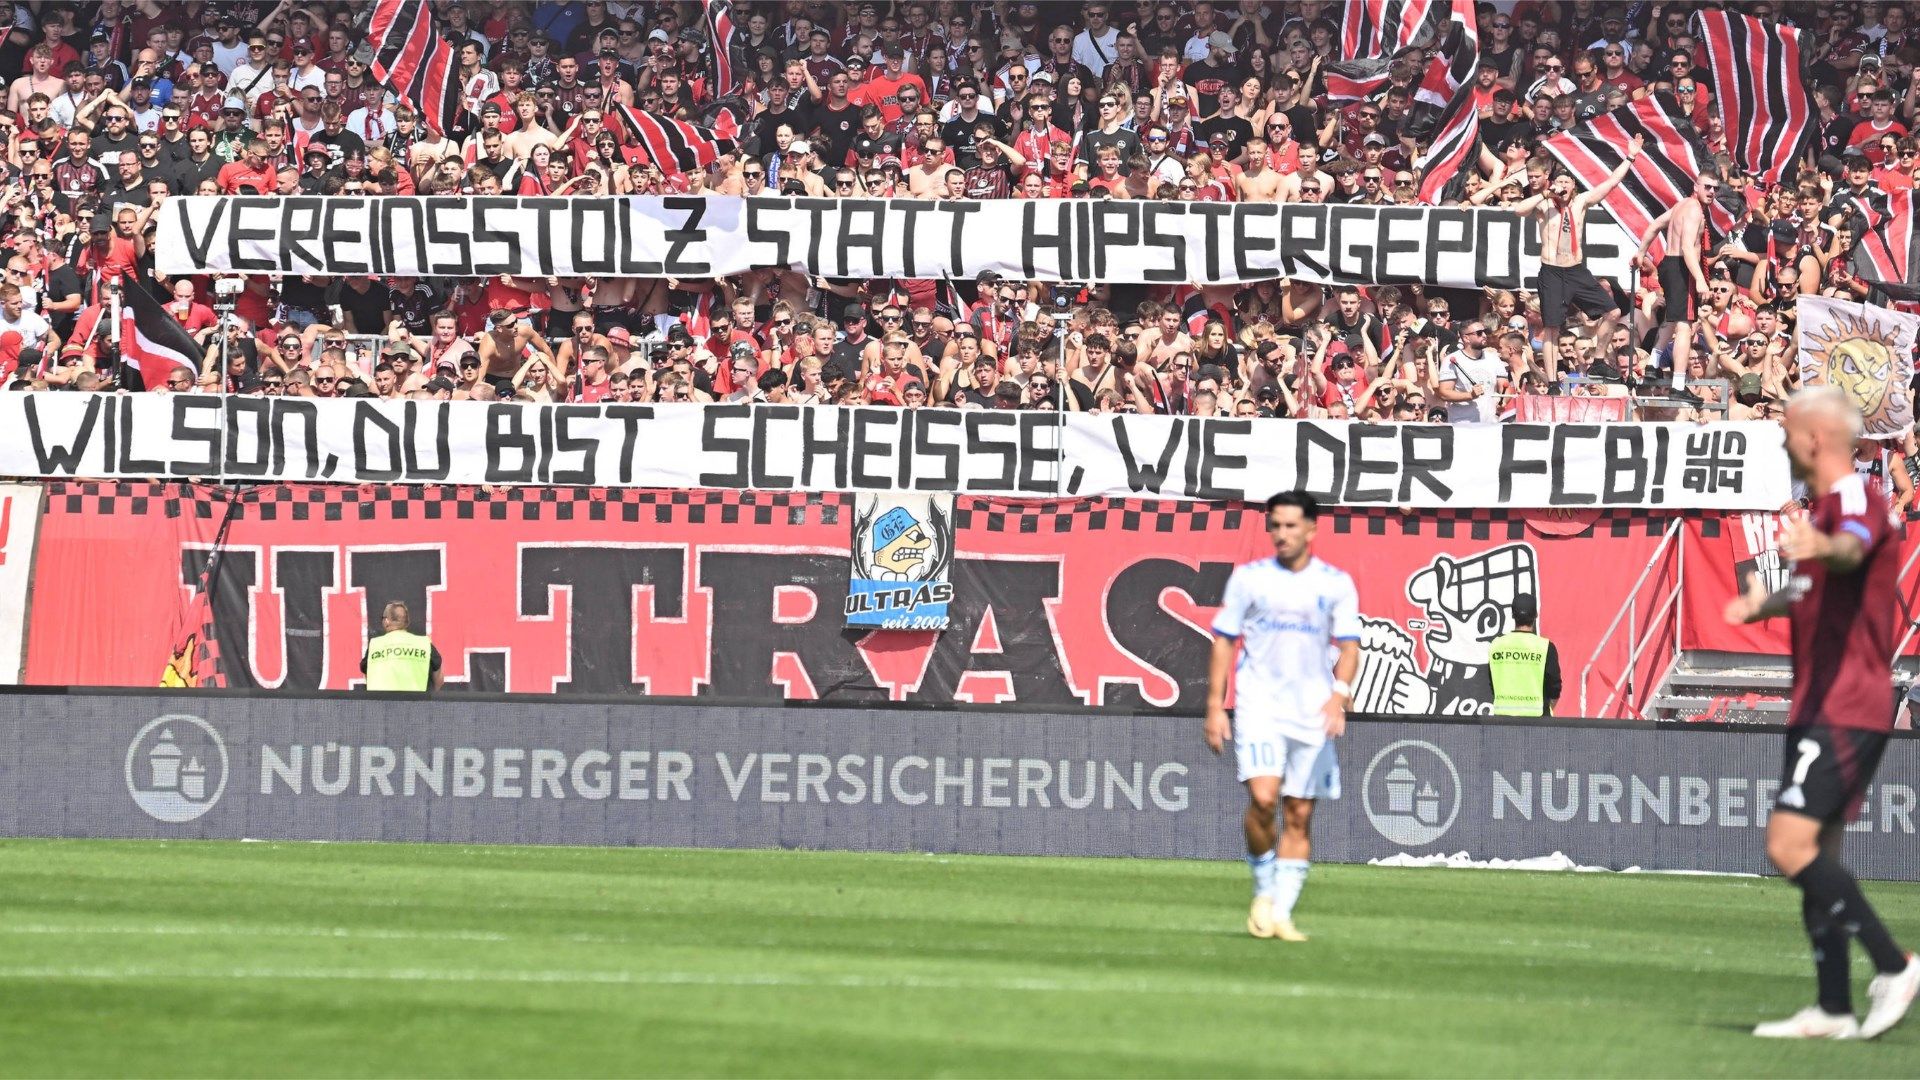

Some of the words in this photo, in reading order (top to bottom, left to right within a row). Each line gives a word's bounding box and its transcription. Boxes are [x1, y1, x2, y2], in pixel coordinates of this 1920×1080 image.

[177, 197, 711, 276] VEREINSSTOLZ
[747, 197, 981, 278] STATT
[23, 393, 339, 479] WILSON,
[352, 400, 451, 482] DU
[484, 402, 655, 489] BIST
[699, 402, 1085, 496] SCHEISSE,
[1111, 415, 1252, 500] WIE
[1294, 421, 1455, 505] DER
[1498, 423, 1670, 505] FCB!
[844, 582, 954, 615] ULTRAS
[178, 541, 1236, 708] ULTRAS
[881, 615, 910, 629] seit
[911, 616, 950, 629] 2002
[386, 647, 427, 659] POWER
[1505, 651, 1542, 662] POWER
[260, 741, 694, 802] NÜRNBERGER
[715, 750, 1189, 813] VERSICHERUNG
[1250, 742, 1276, 768] 10
[1792, 738, 1821, 784] 7
[1492, 768, 1917, 835] NÜRNBER
